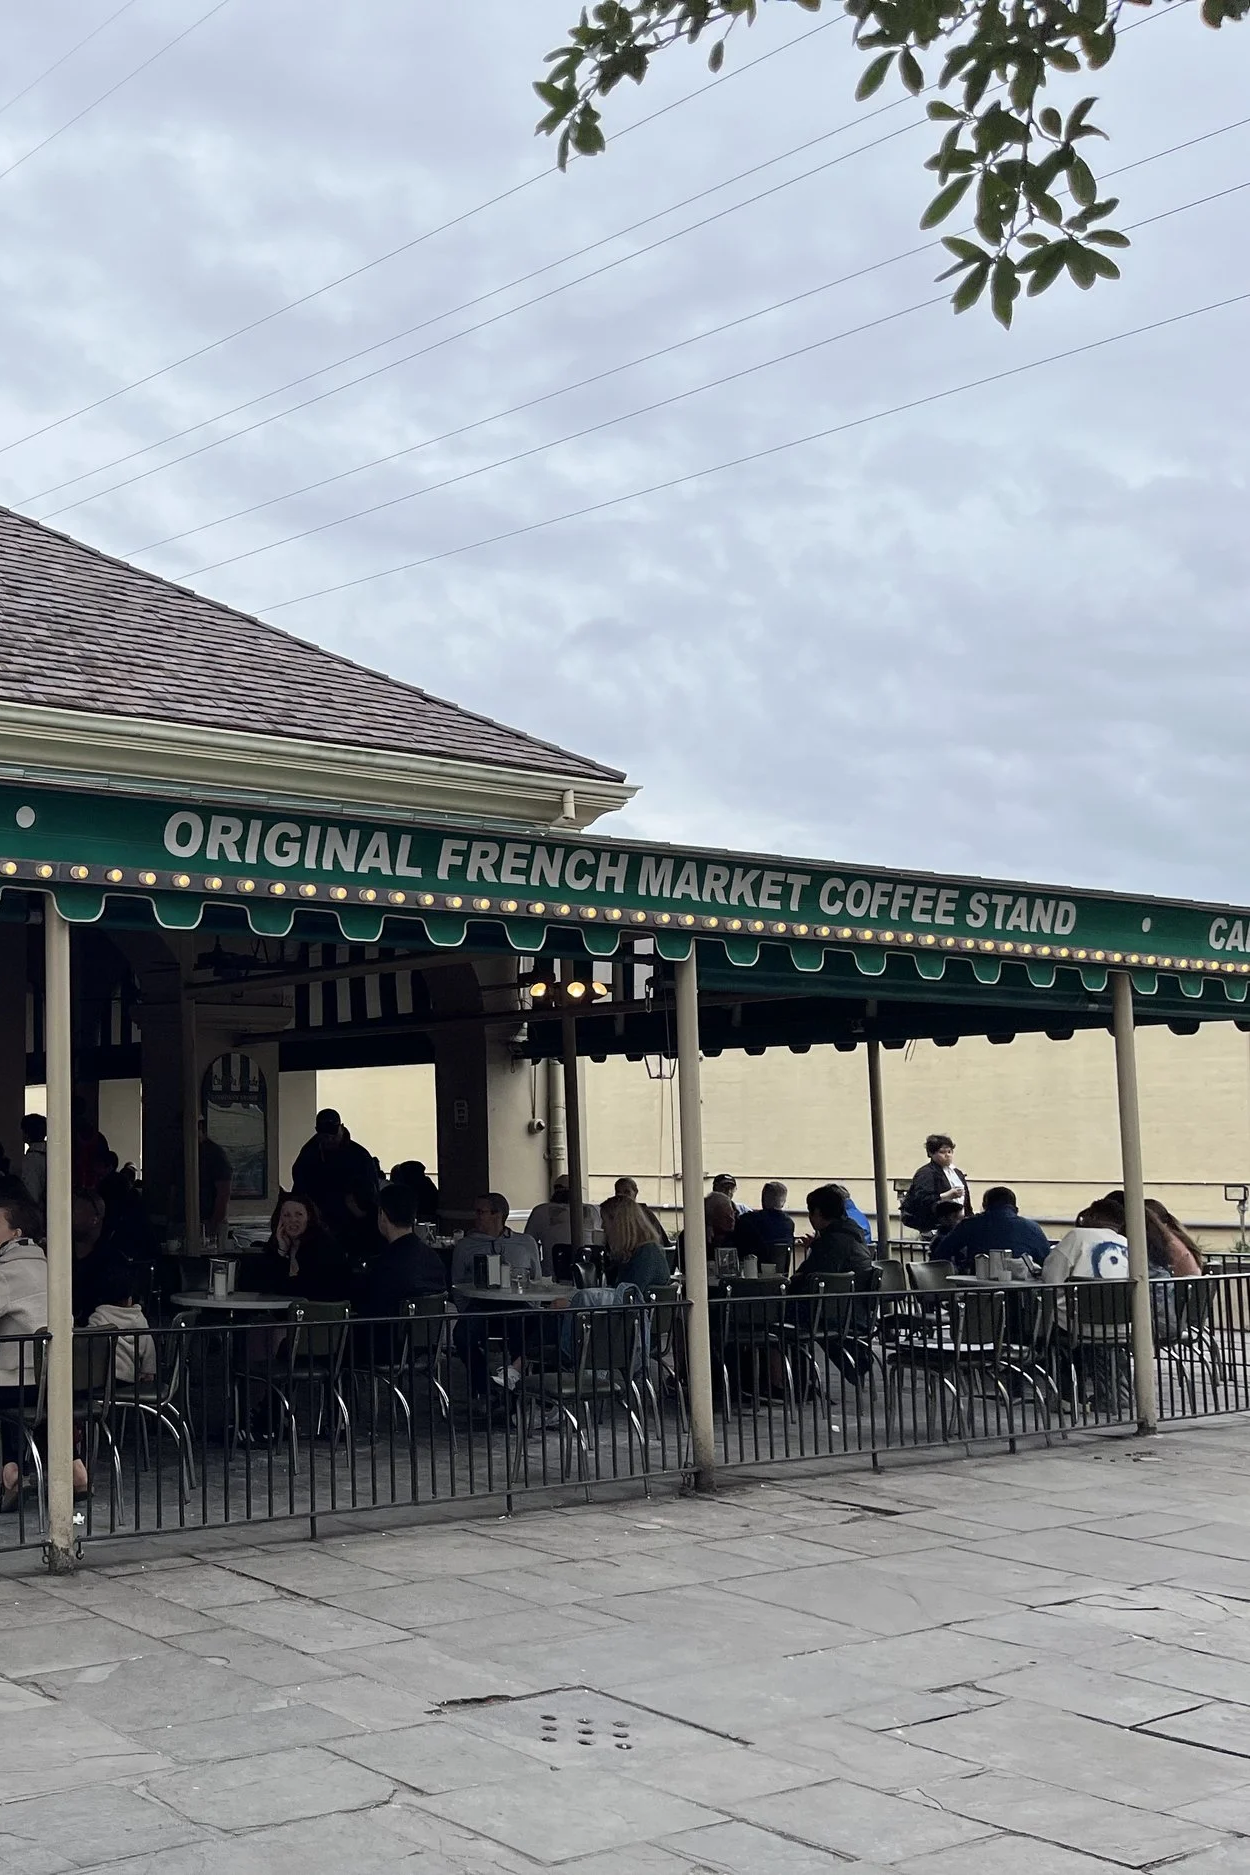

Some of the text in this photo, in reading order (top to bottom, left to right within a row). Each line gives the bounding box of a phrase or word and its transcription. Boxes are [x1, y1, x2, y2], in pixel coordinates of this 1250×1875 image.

[163, 811, 1077, 936] ORIGINAL FRENCH MARKET COFFEE STAND
[1208, 917, 1250, 953] CA
